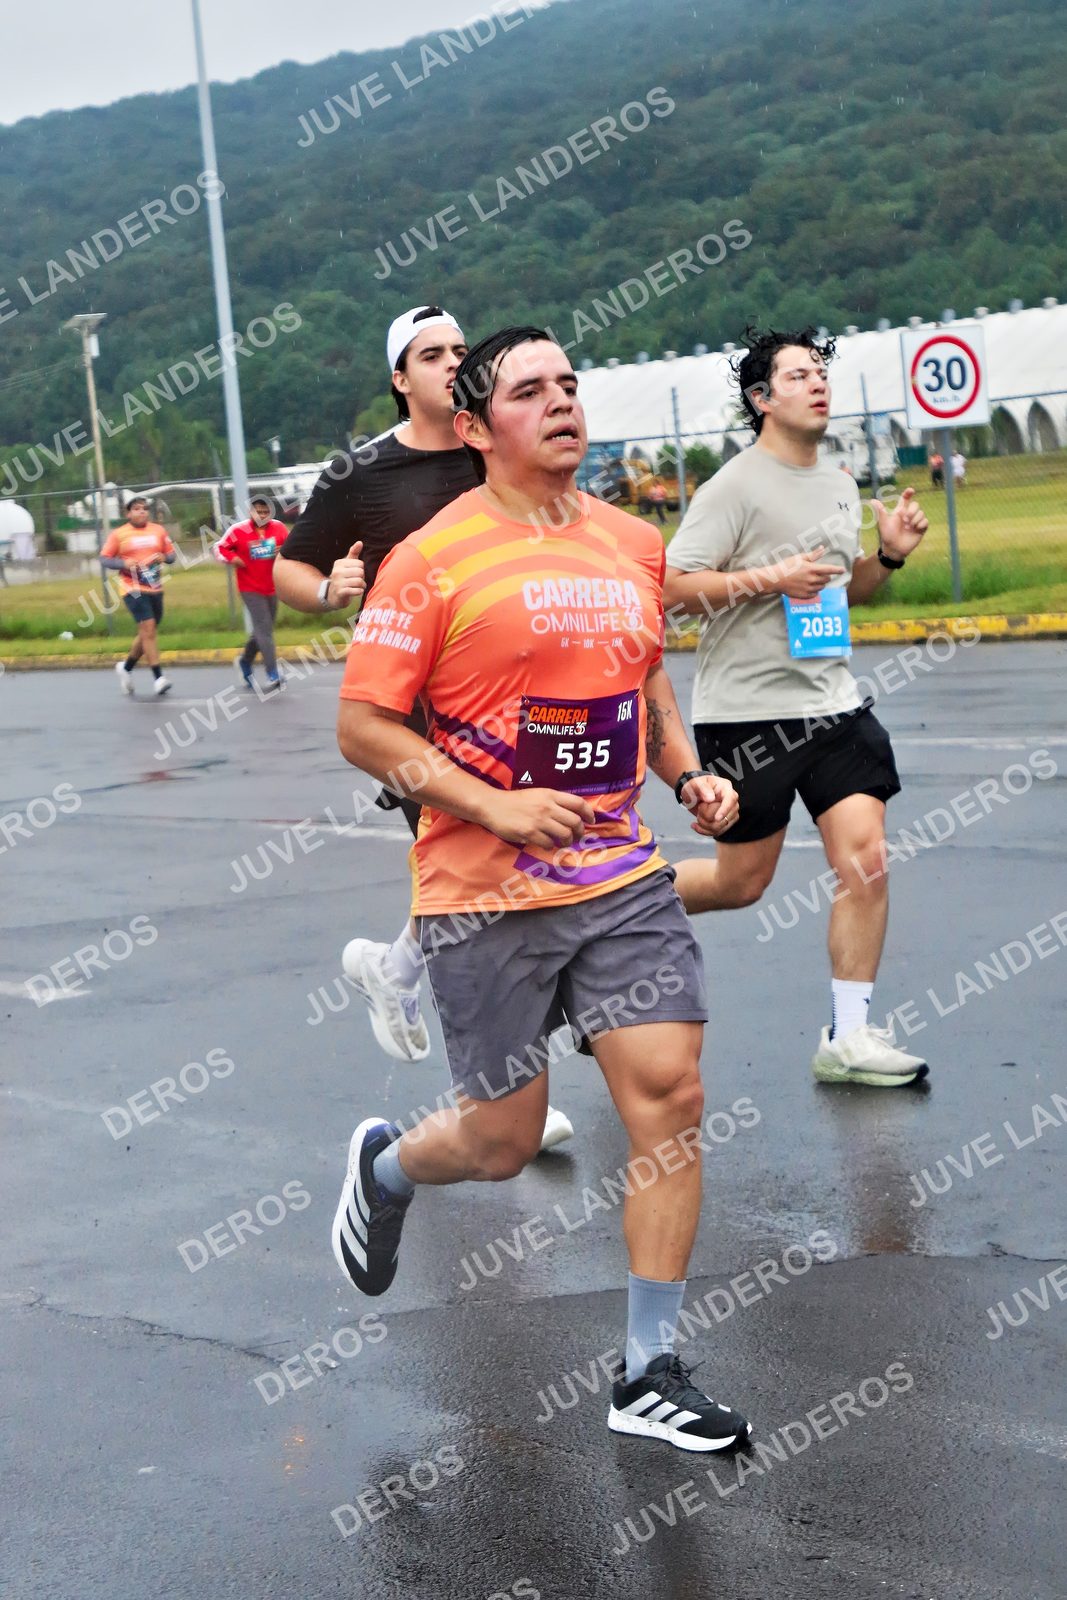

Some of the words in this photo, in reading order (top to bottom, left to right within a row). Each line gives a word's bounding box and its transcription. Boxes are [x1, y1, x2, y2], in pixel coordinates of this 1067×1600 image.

[923, 356, 967, 392] 30
[523, 578, 641, 610] CARRERA
[800, 616, 843, 638] 2033
[529, 706, 589, 724] CARRERA
[616, 700, 633, 722] 15K
[554, 740, 611, 771] 535
